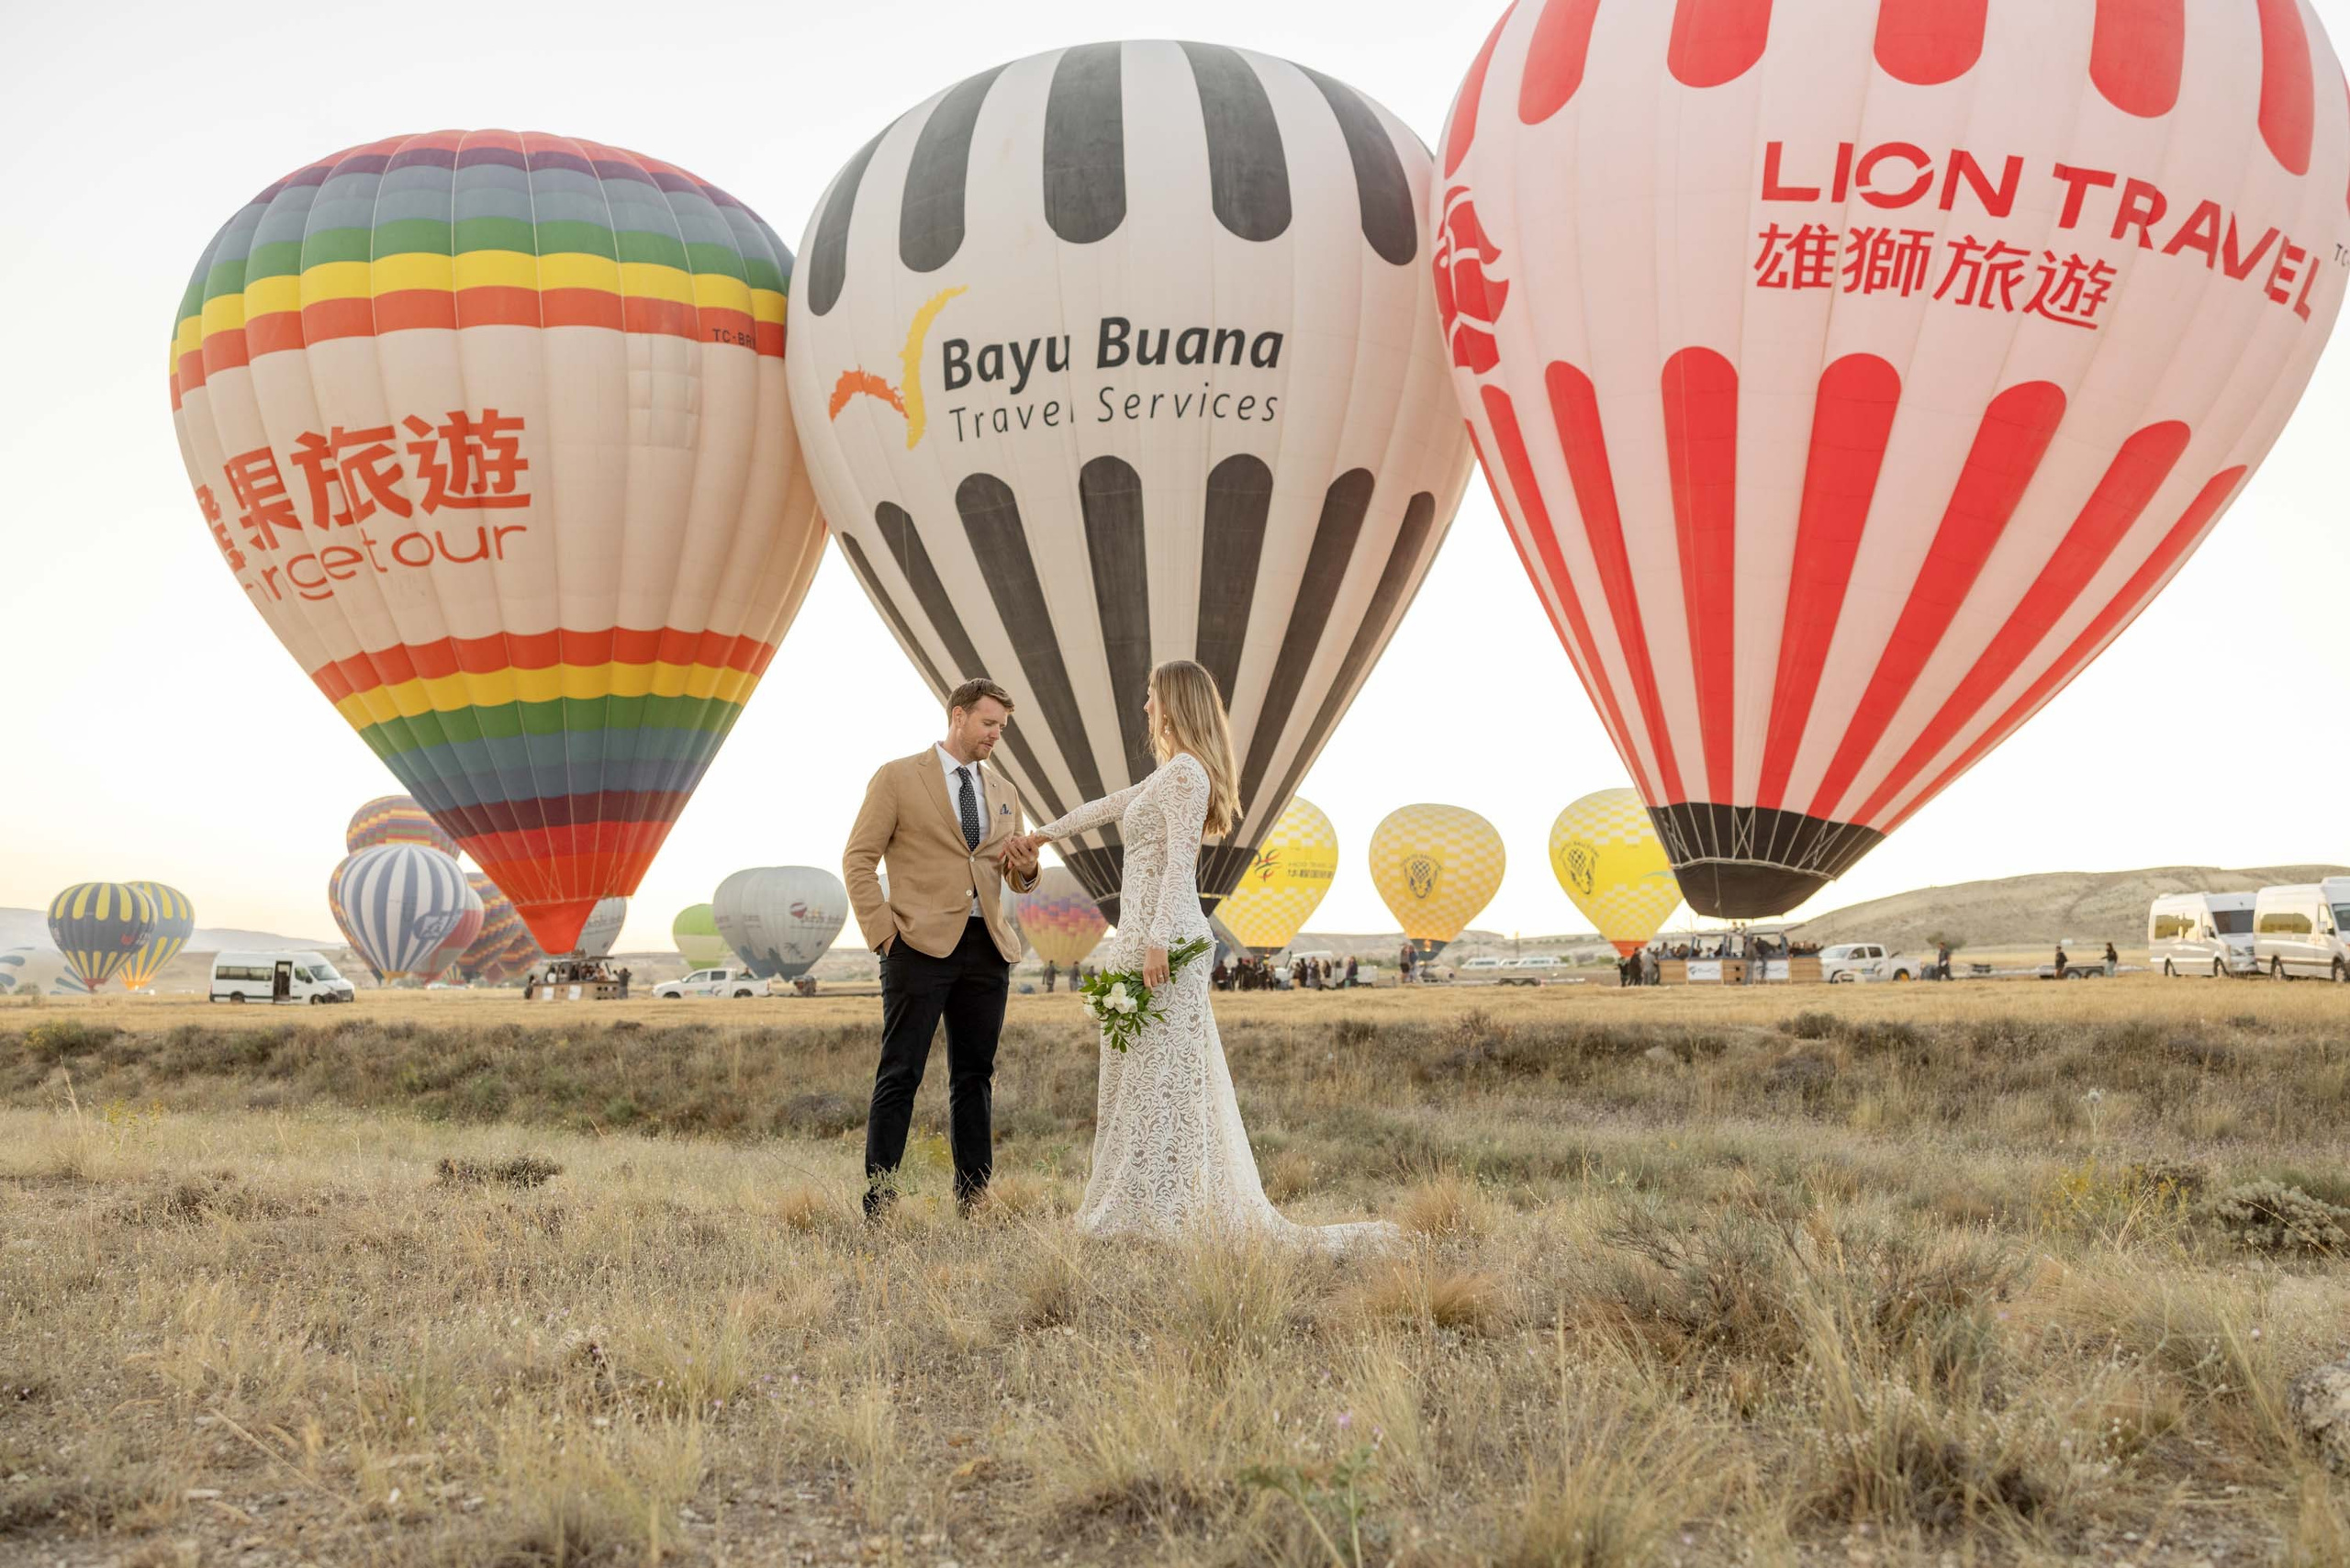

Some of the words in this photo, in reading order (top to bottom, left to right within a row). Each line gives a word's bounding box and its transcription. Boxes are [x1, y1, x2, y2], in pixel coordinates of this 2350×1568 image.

[1753, 222, 2118, 330] 雄獅旅遊
[1762, 141, 2024, 218] LION
[2052, 162, 2322, 323] TRAVEL
[942, 335, 1070, 395] Bayu
[1096, 316, 1283, 369] Buana
[1097, 382, 1279, 423] Services
